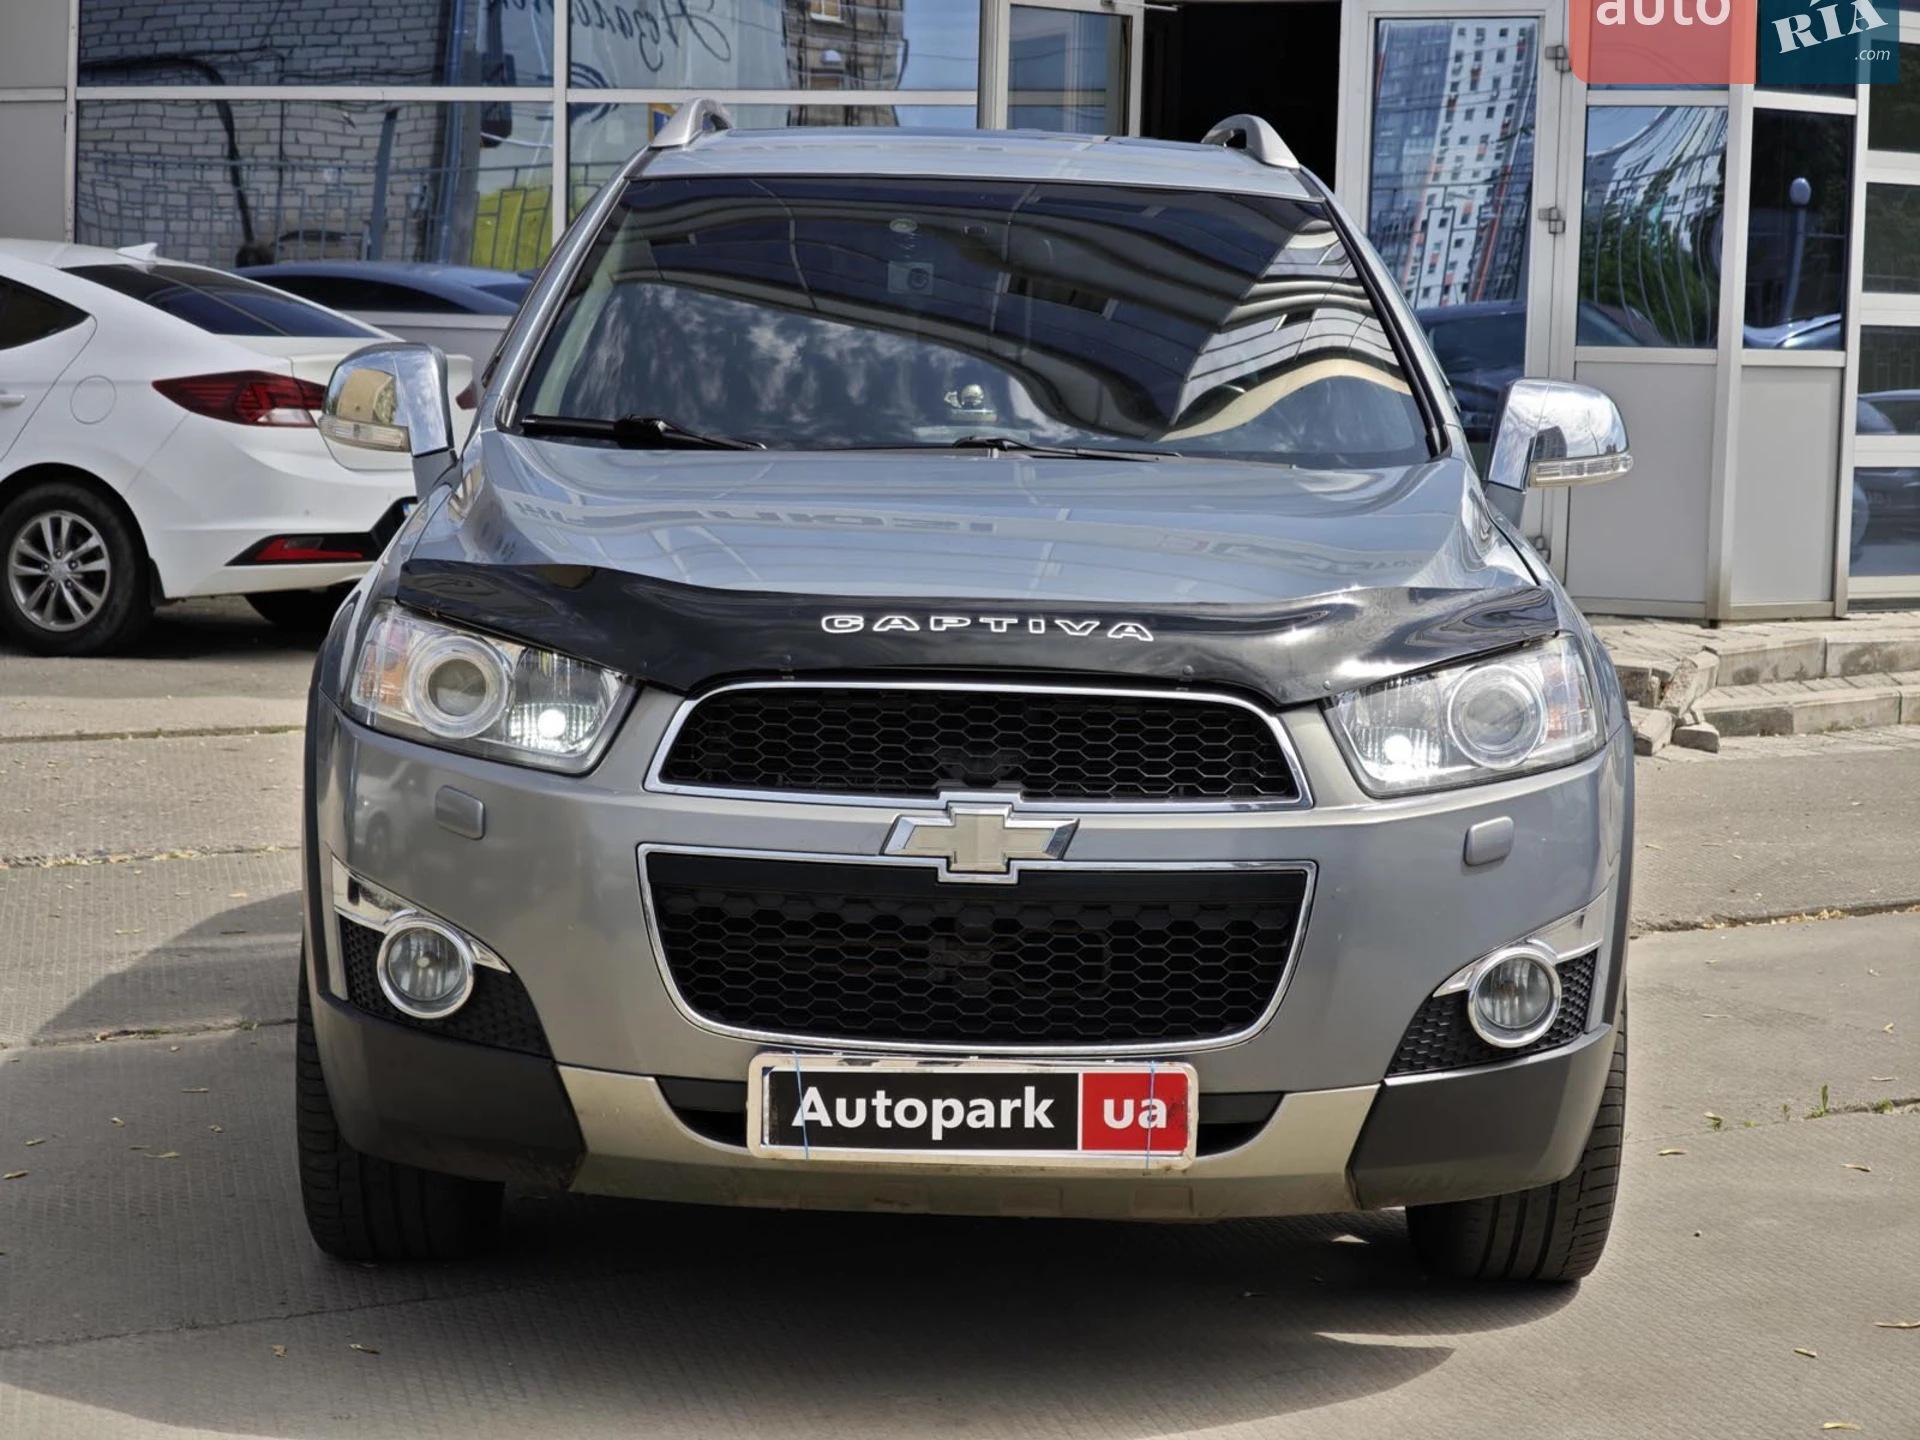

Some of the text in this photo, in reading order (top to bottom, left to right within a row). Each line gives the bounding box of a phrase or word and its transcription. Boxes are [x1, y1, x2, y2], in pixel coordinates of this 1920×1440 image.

[821, 615, 1154, 641] CAPTIVA
[791, 1086, 1167, 1141] Autopark ua
